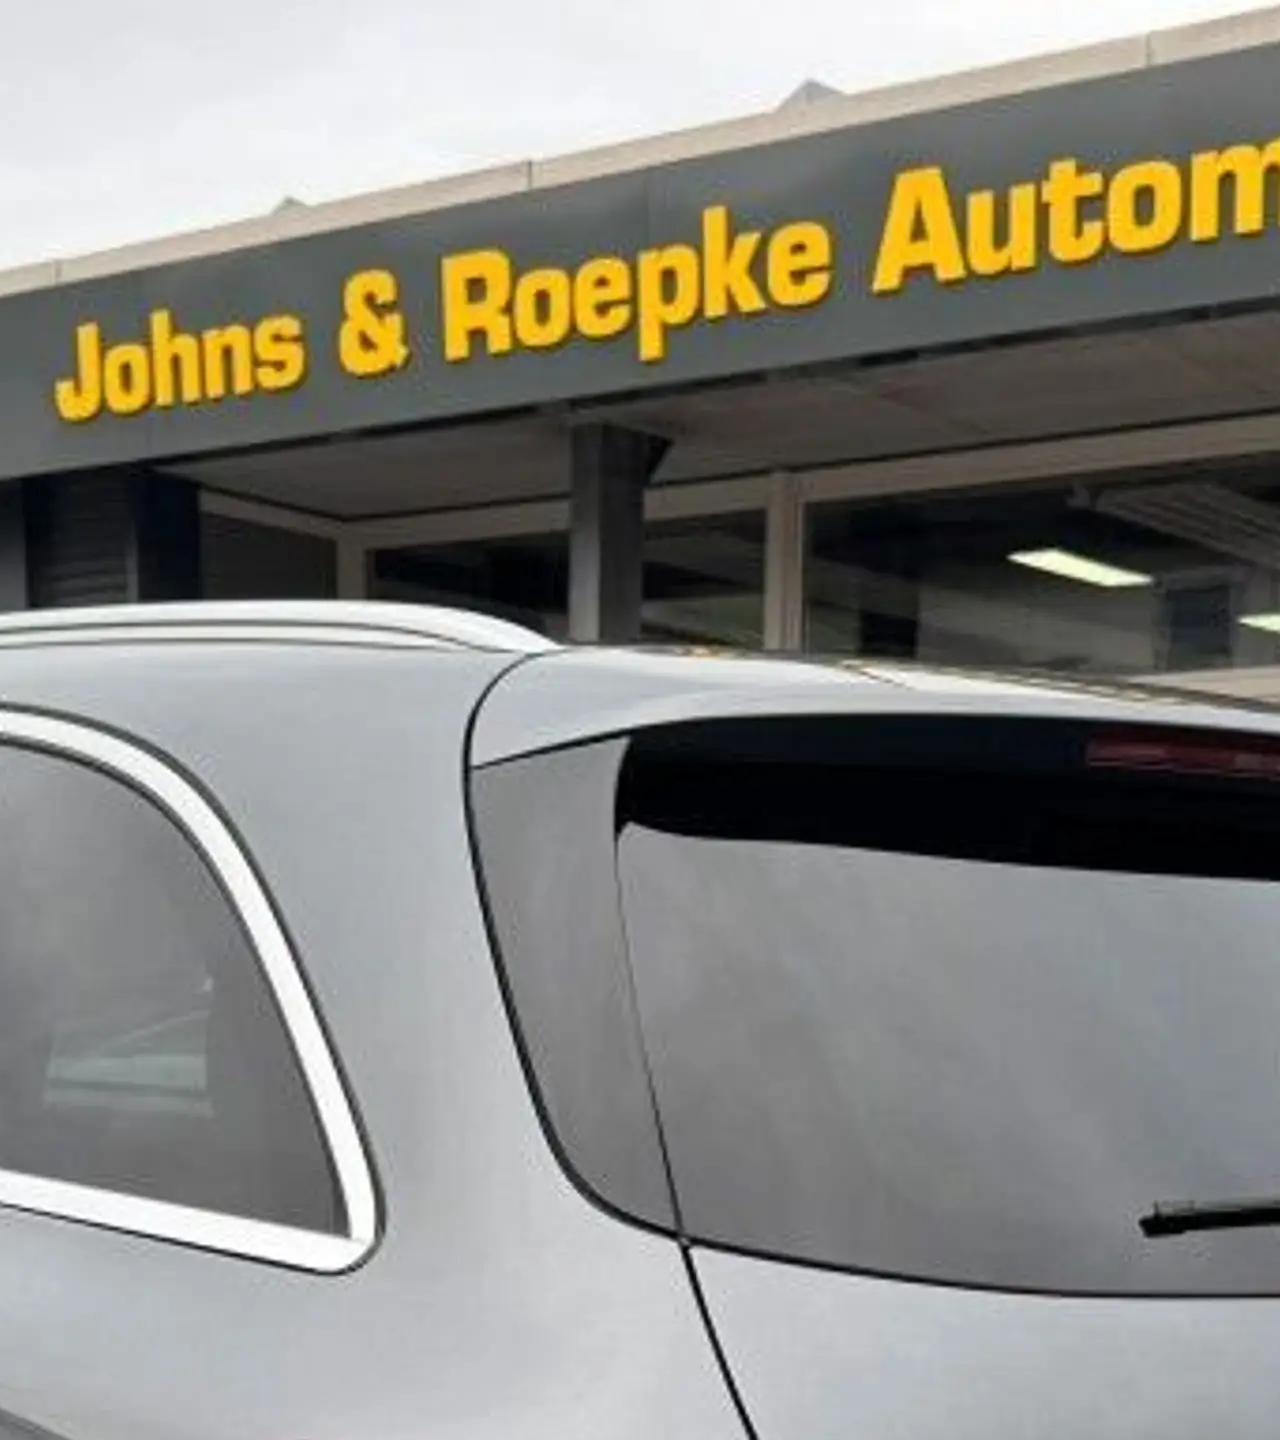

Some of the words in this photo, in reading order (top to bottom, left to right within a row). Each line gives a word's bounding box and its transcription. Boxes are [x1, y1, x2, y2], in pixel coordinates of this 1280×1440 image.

[52, 307, 308, 423] Johns
[336, 266, 411, 378] &
[439, 206, 836, 363] Roepke
